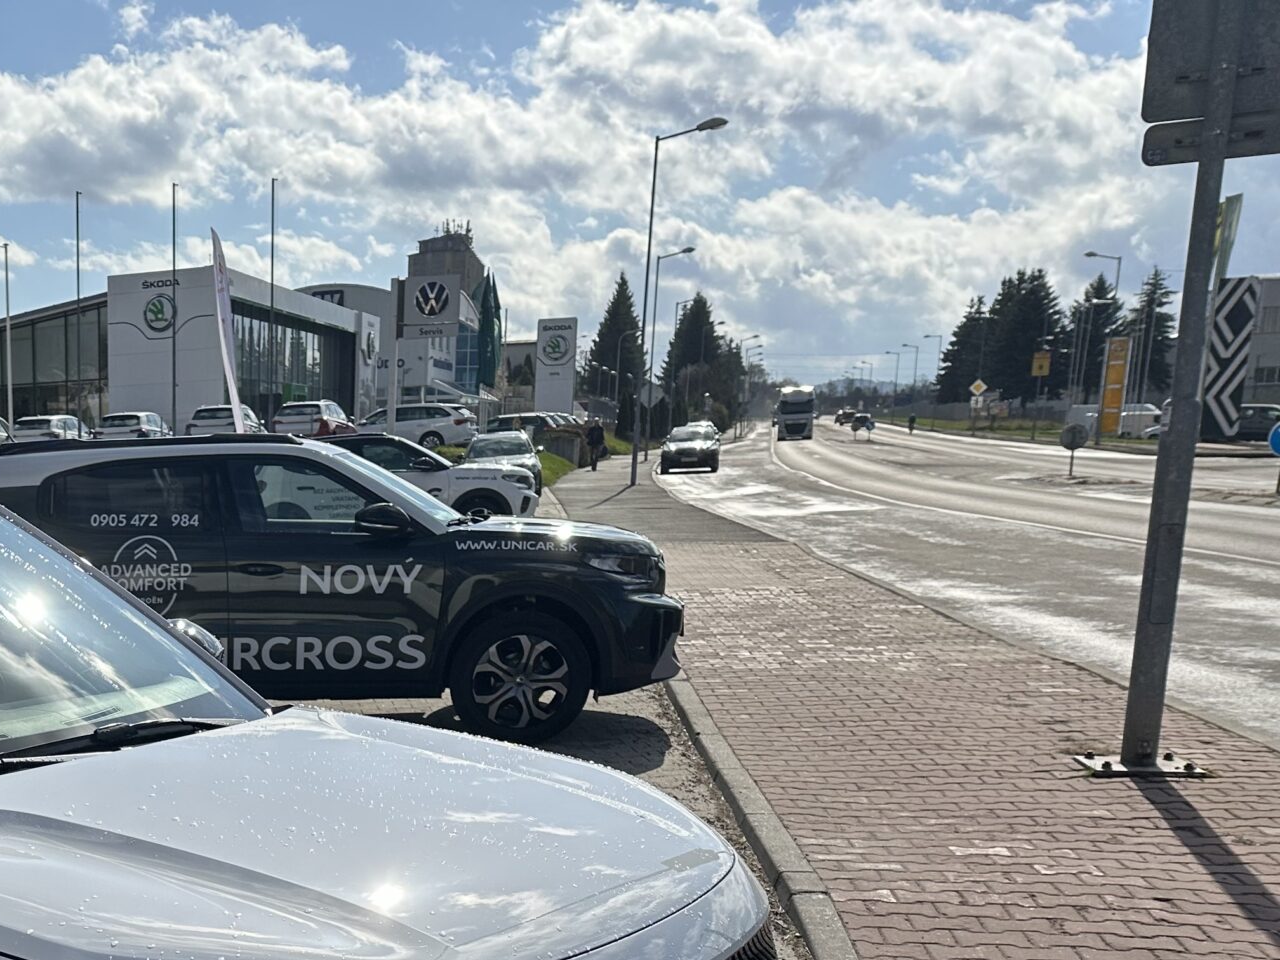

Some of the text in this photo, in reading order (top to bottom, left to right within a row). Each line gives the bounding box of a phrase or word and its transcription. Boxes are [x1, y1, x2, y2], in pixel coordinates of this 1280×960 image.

[419, 328, 443, 336] Servis
[90, 514, 199, 527] 0905 472 984
[455, 540, 578, 552] WWW.UNICAR.SK
[101, 563, 192, 578] ADVANCED
[299, 557, 423, 595] NOVÝ
[117, 577, 187, 591] OMFORT
[220, 635, 426, 671] IRCROSS
